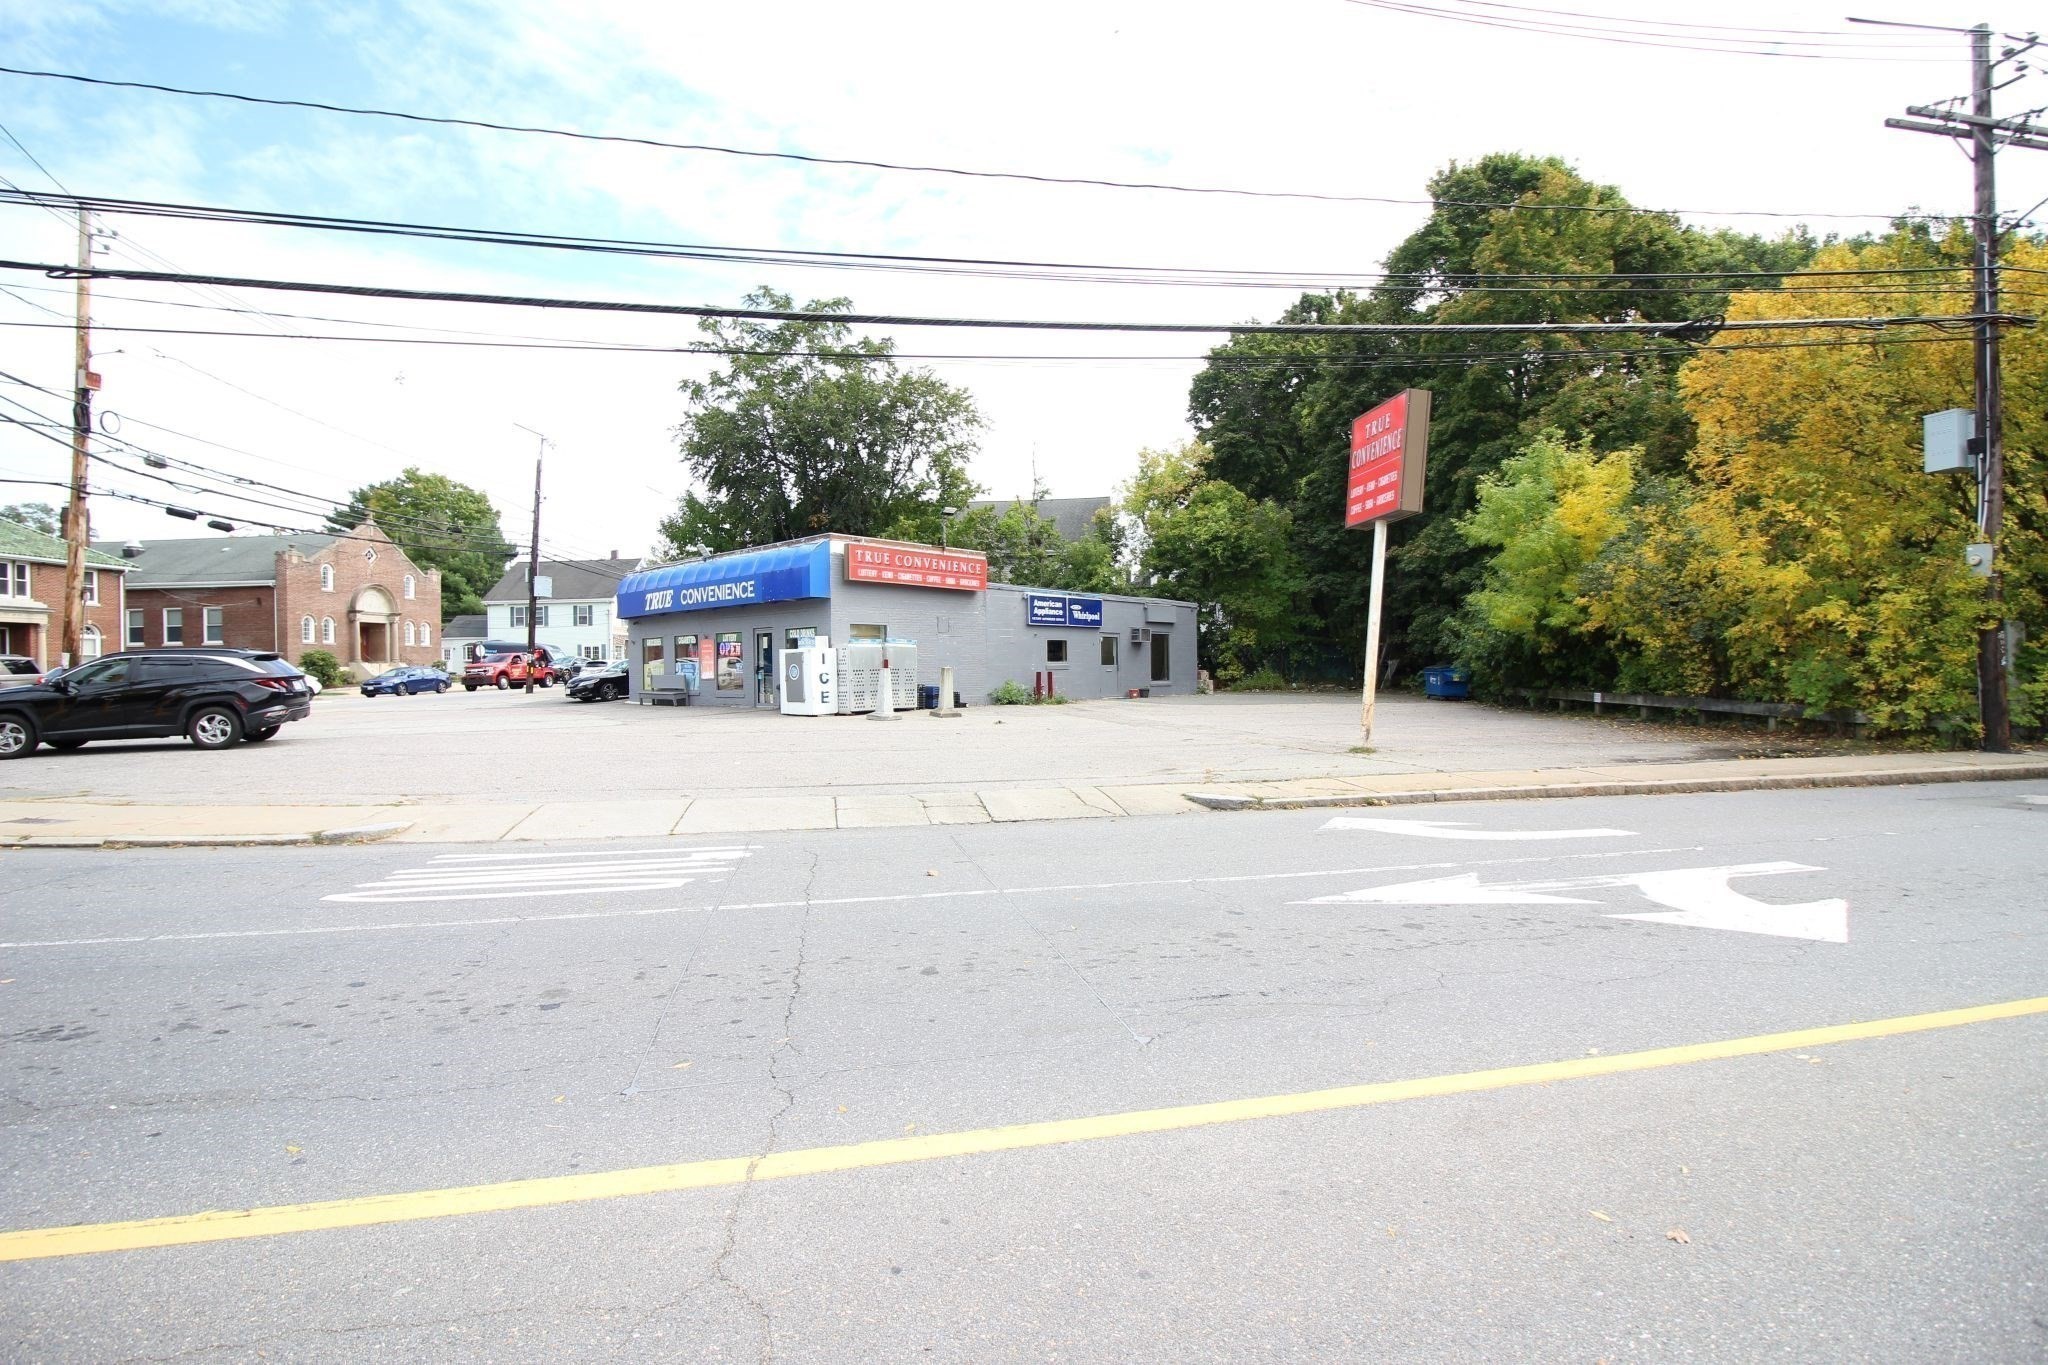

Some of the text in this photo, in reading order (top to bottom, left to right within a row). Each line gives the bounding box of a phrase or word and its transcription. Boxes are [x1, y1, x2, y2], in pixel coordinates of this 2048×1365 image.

[1365, 412, 1391, 438] TRUE
[1352, 427, 1402, 469] CONVENIENCE
[856, 550, 982, 574] TRUE CONVENIENCE
[645, 580, 755, 610] TRUE CONVENIENCE
[1034, 598, 1062, 608] American
[1034, 607, 1064, 616] Appliance
[1072, 610, 1100, 622] Whirlpool
[720, 642, 741, 656] OPEN
[818, 653, 830, 704] ICE
